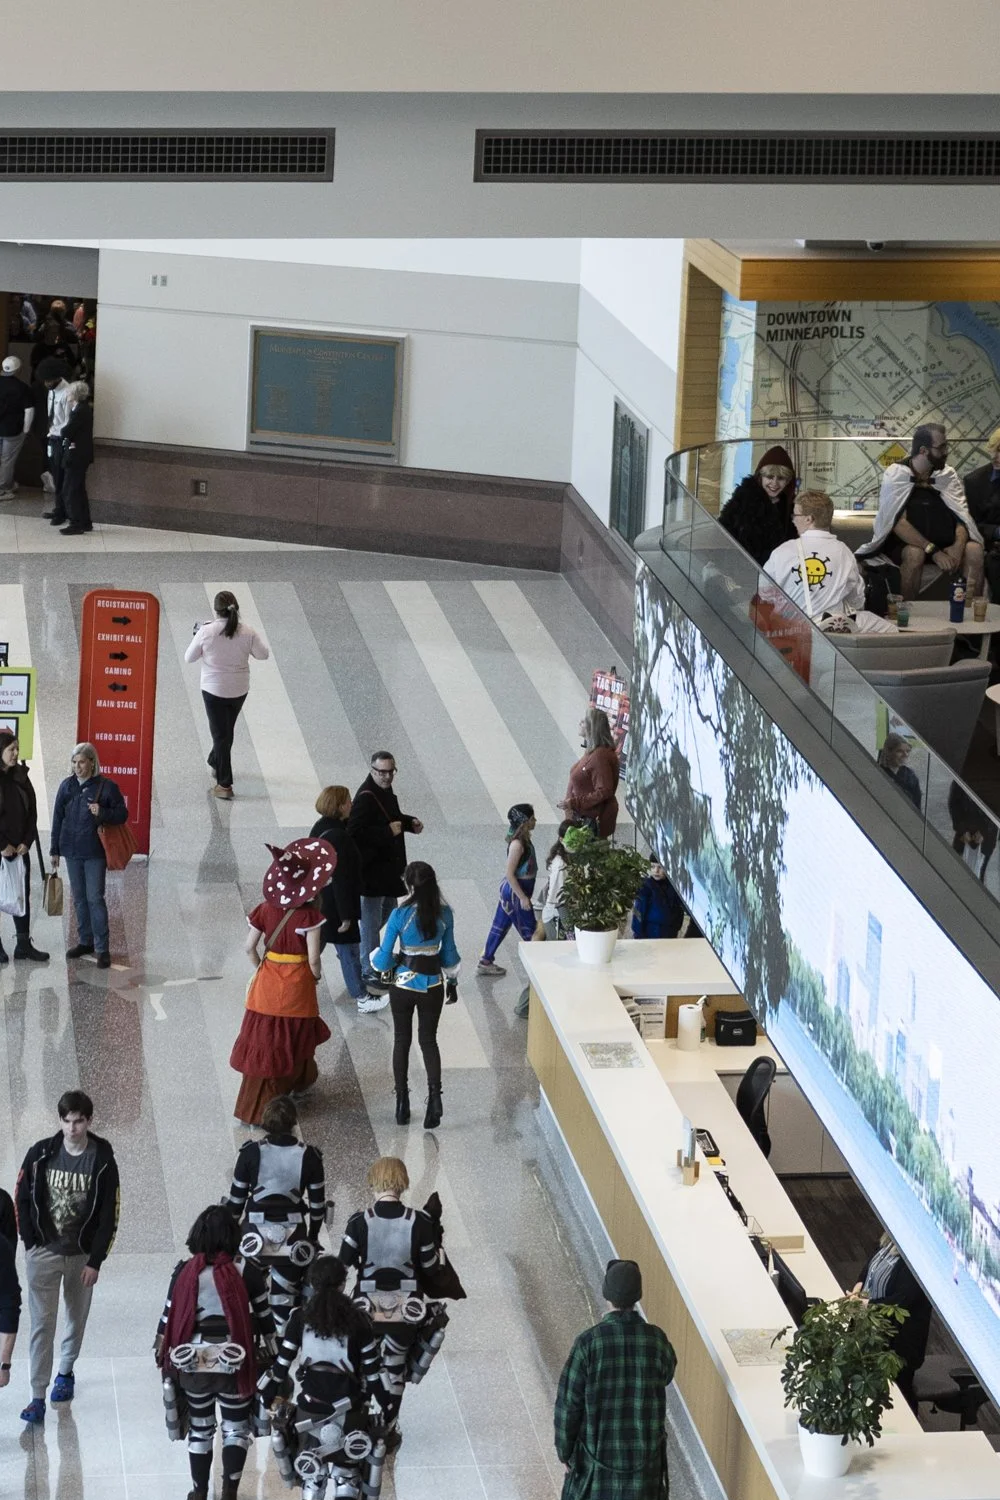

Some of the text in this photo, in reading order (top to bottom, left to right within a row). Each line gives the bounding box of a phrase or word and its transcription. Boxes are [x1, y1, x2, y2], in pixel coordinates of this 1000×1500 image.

[767, 309, 852, 326] DOWNTOWN
[766, 325, 865, 343] MINNEAPOLIS
[97, 599, 146, 610] REGISTRATION
[97, 633, 143, 643] EXHIBIT HALL
[104, 666, 132, 676] GAMING
[597, 676, 610, 690] TAG
[96, 699, 138, 710] MAIN STAGE
[95, 732, 136, 742] HERO STAGE
[112, 766, 138, 776] ROOMS
